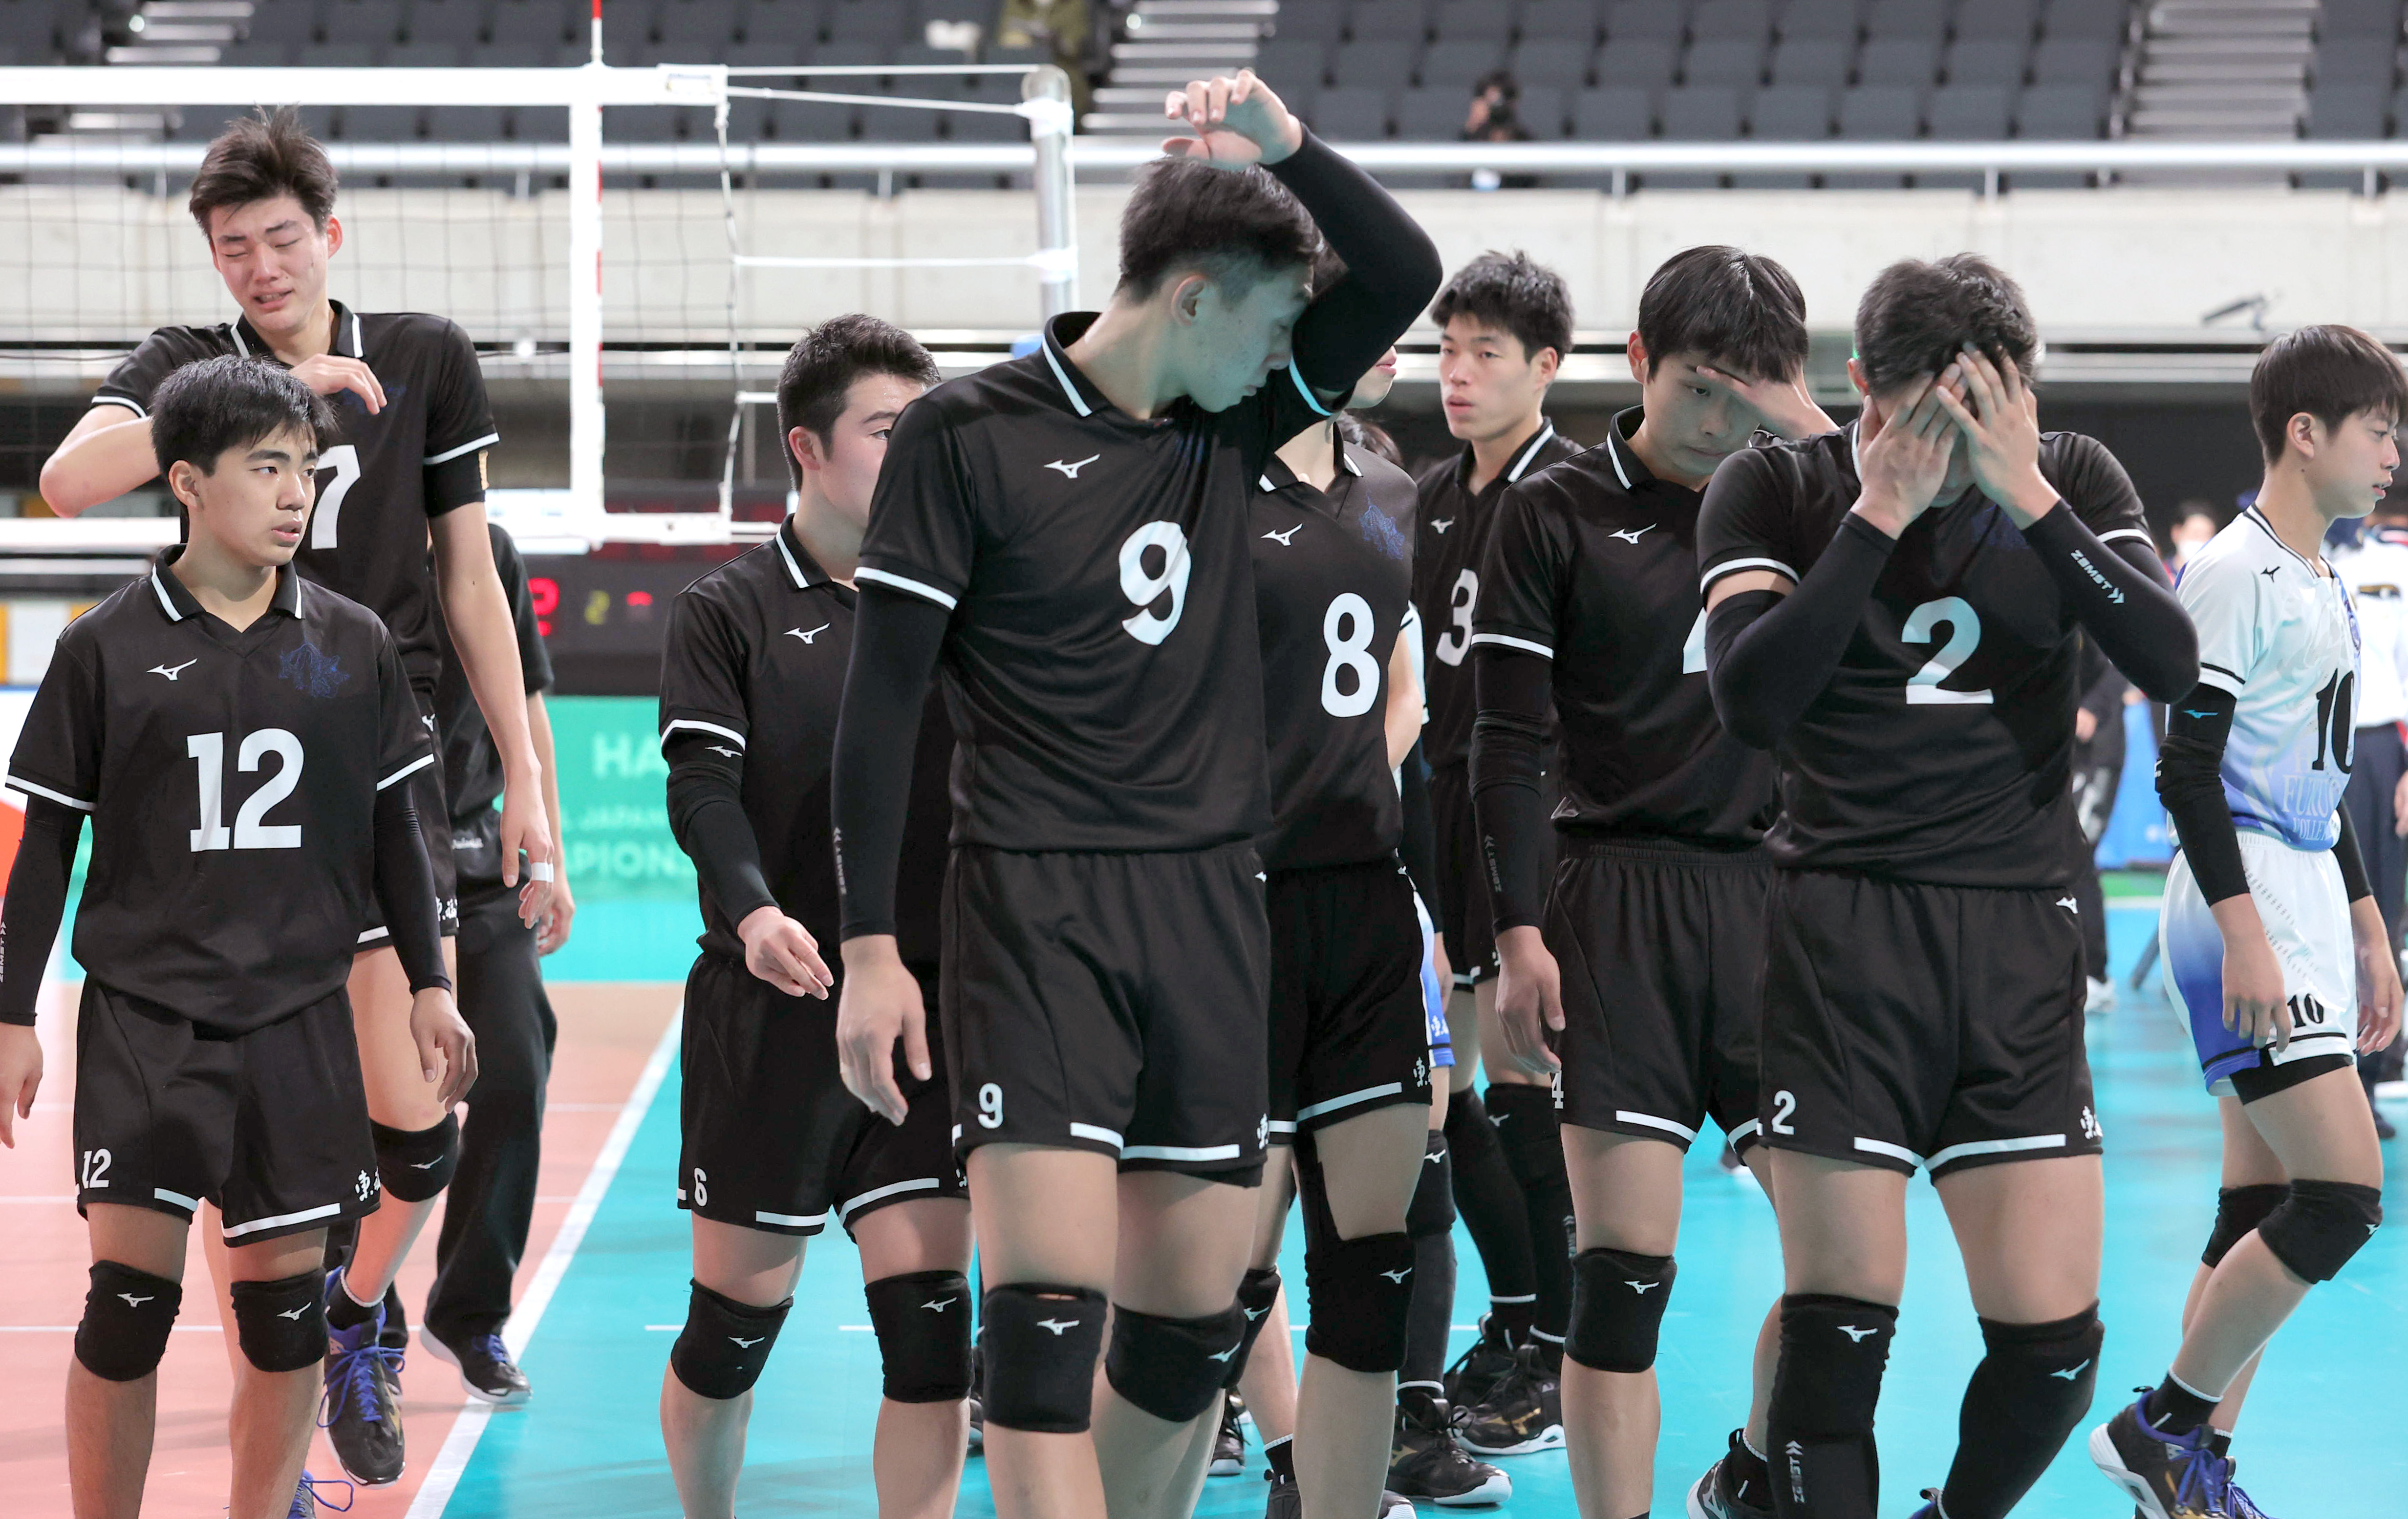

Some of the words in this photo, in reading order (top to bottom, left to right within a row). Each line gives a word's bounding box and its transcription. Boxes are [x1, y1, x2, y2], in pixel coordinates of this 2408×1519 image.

[311, 445, 361, 549] 7
[1119, 520, 1191, 645] 9
[1436, 569, 1479, 666] 3
[1321, 593, 1380, 718] 8
[1901, 597, 1994, 704] 2
[2312, 668, 2354, 774] 10
[187, 728, 304, 852] 12
[2287, 993, 2323, 1028] 10
[978, 1083, 1003, 1129] 9
[1552, 1070, 1564, 1109] 4
[1772, 1090, 1796, 1135] 2
[82, 1148, 111, 1189] 12
[694, 1167, 708, 1207] 6
